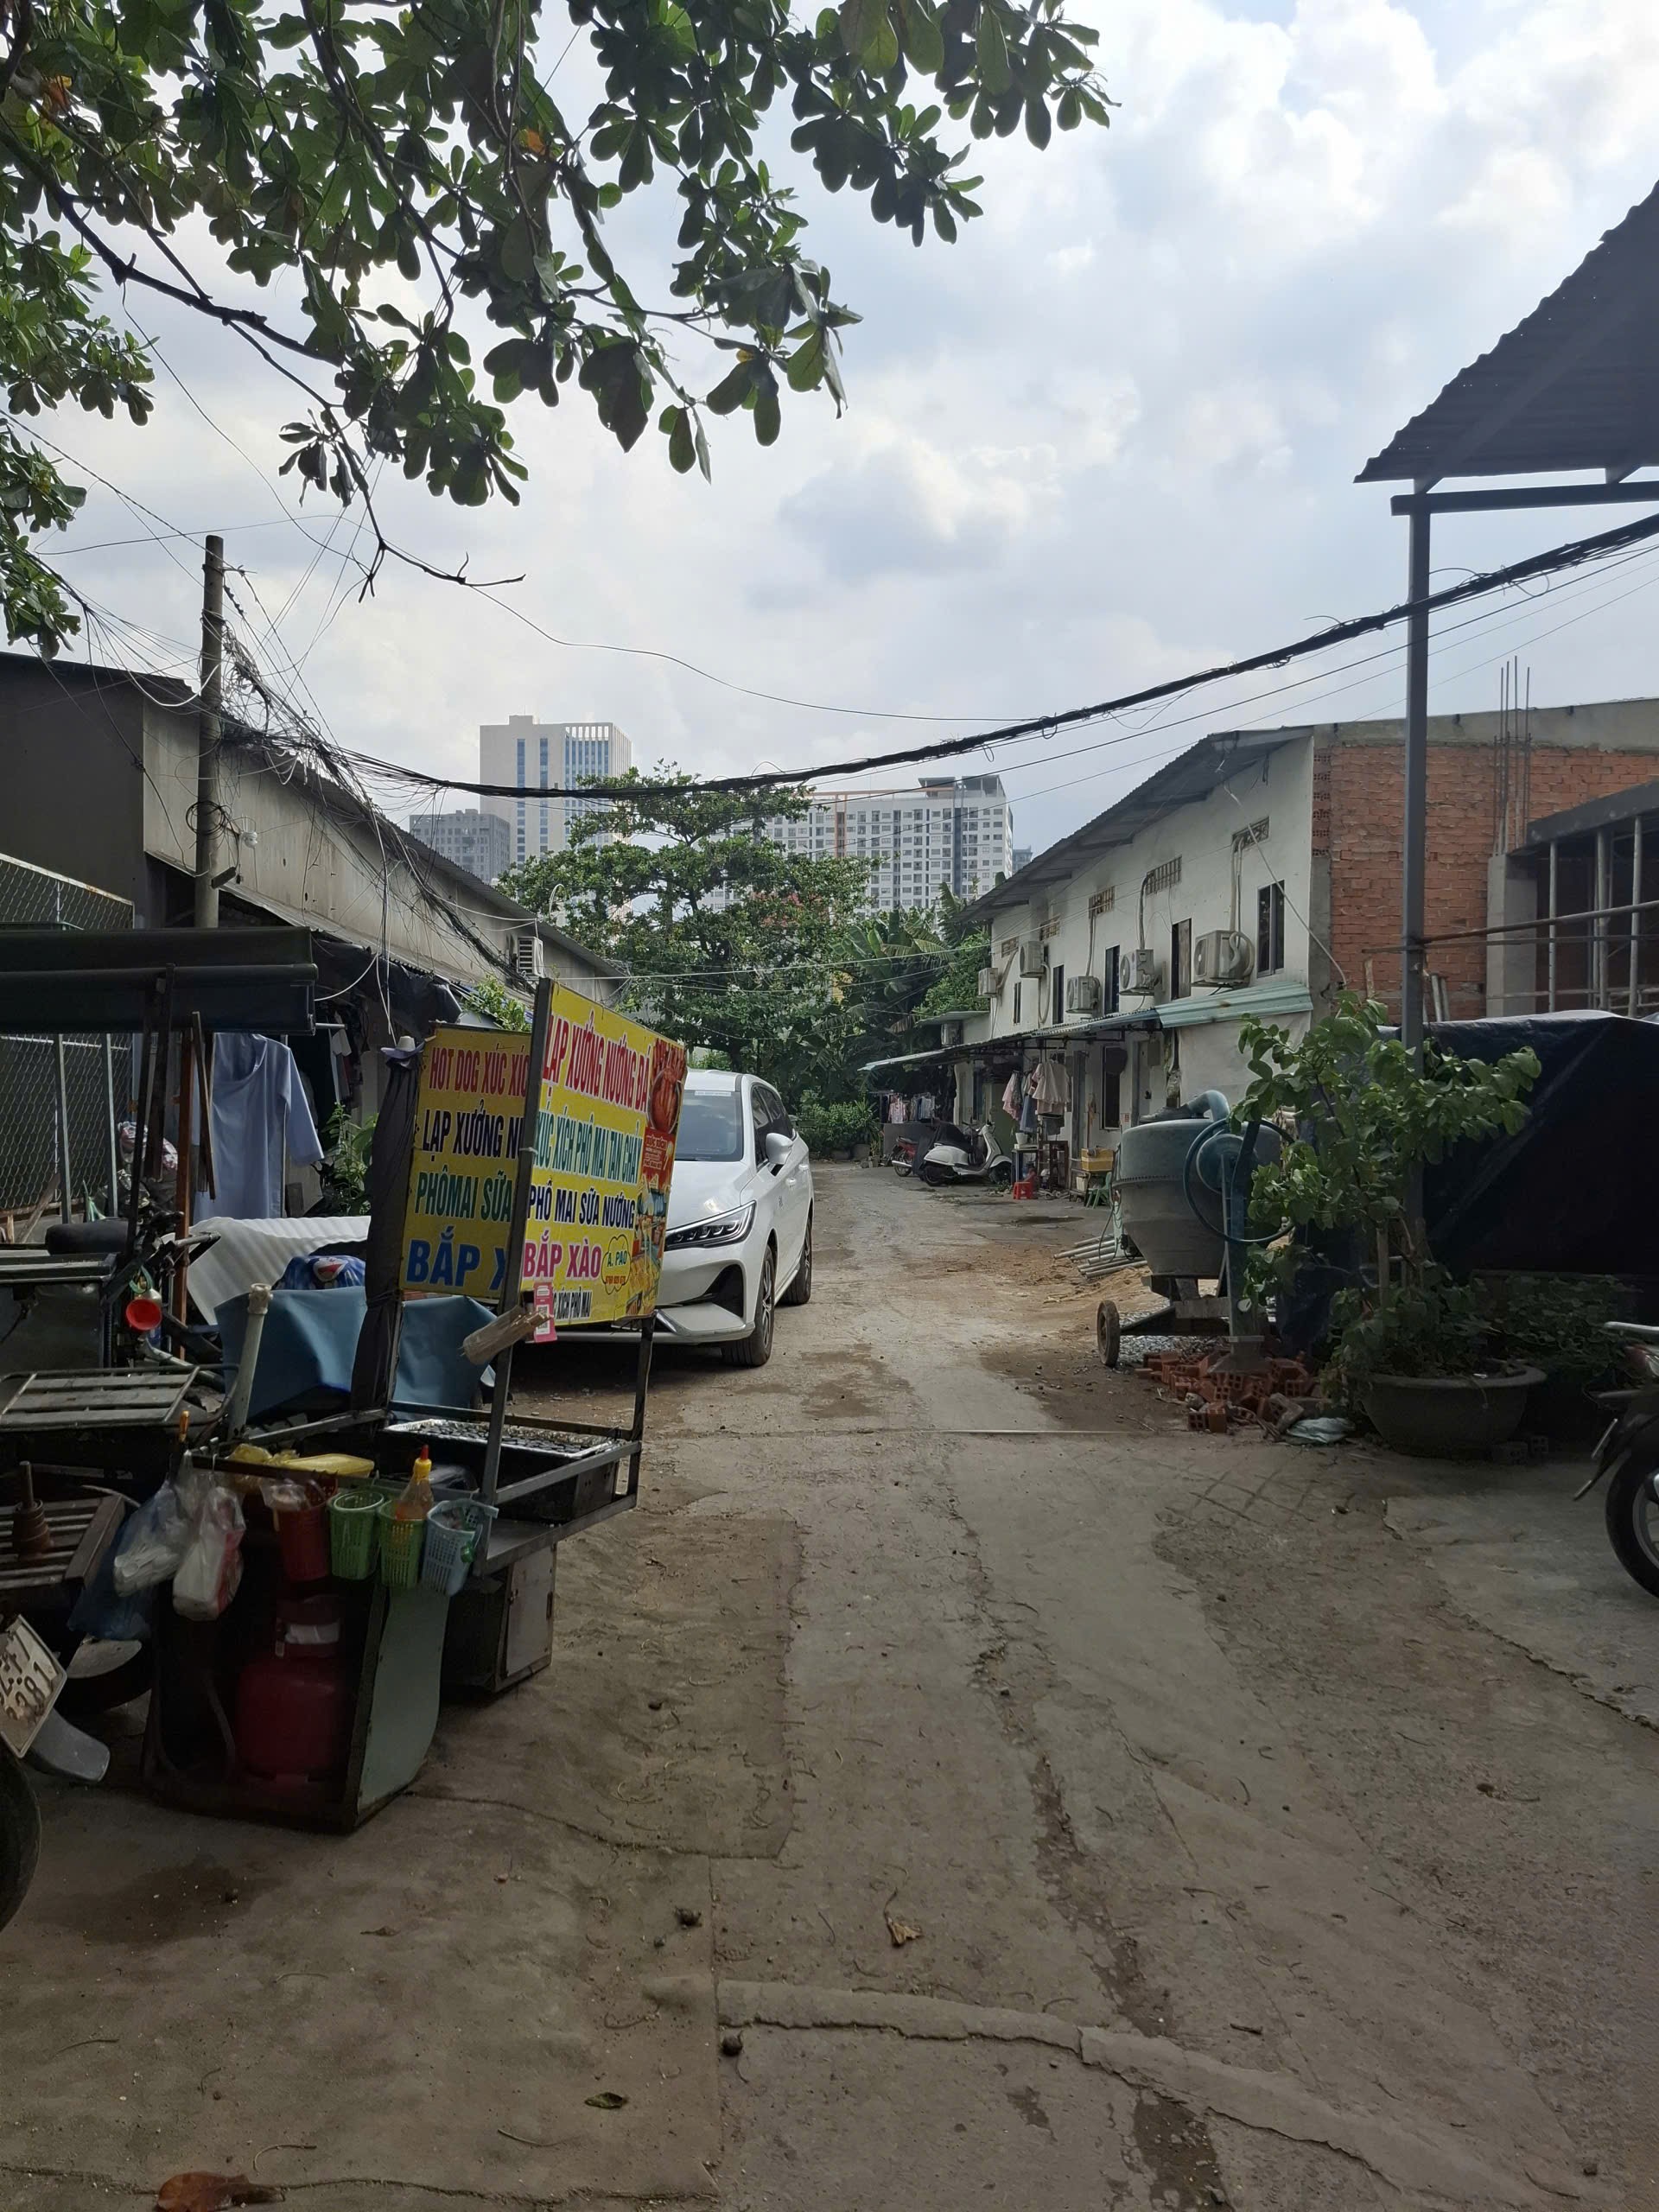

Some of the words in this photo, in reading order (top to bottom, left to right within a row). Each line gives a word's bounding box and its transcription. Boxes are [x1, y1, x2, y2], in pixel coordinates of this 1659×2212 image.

[429, 1047, 454, 1090] HOT
[454, 1050, 480, 1092] DOG
[481, 1043, 508, 1095] XÚC
[508, 1046, 531, 1097] XÍC
[543, 1014, 569, 1096] LẠP
[565, 1010, 605, 1097] XƯỞNG
[601, 1033, 637, 1109] NƯỚNG
[635, 1045, 651, 1113] ĐÁ
[423, 1109, 451, 1161] LẠP
[453, 1099, 504, 1158] XƯỞNG
[552, 1106, 576, 1172] XÍCH
[574, 1114, 593, 1176] PHÔ
[591, 1126, 610, 1179] MAI
[607, 1131, 624, 1181] TAN
[621, 1121, 643, 1185] CHẢY
[415, 1165, 479, 1218] PHÔMAI
[480, 1170, 512, 1222] SỮA
[554, 1188, 577, 1224] MAI
[579, 1187, 600, 1225] SỮA
[601, 1192, 635, 1230] NƯỚNG
[406, 1226, 480, 1287] BẮP
[524, 1230, 563, 1278] BẮP
[566, 1239, 602, 1278] XÀO
